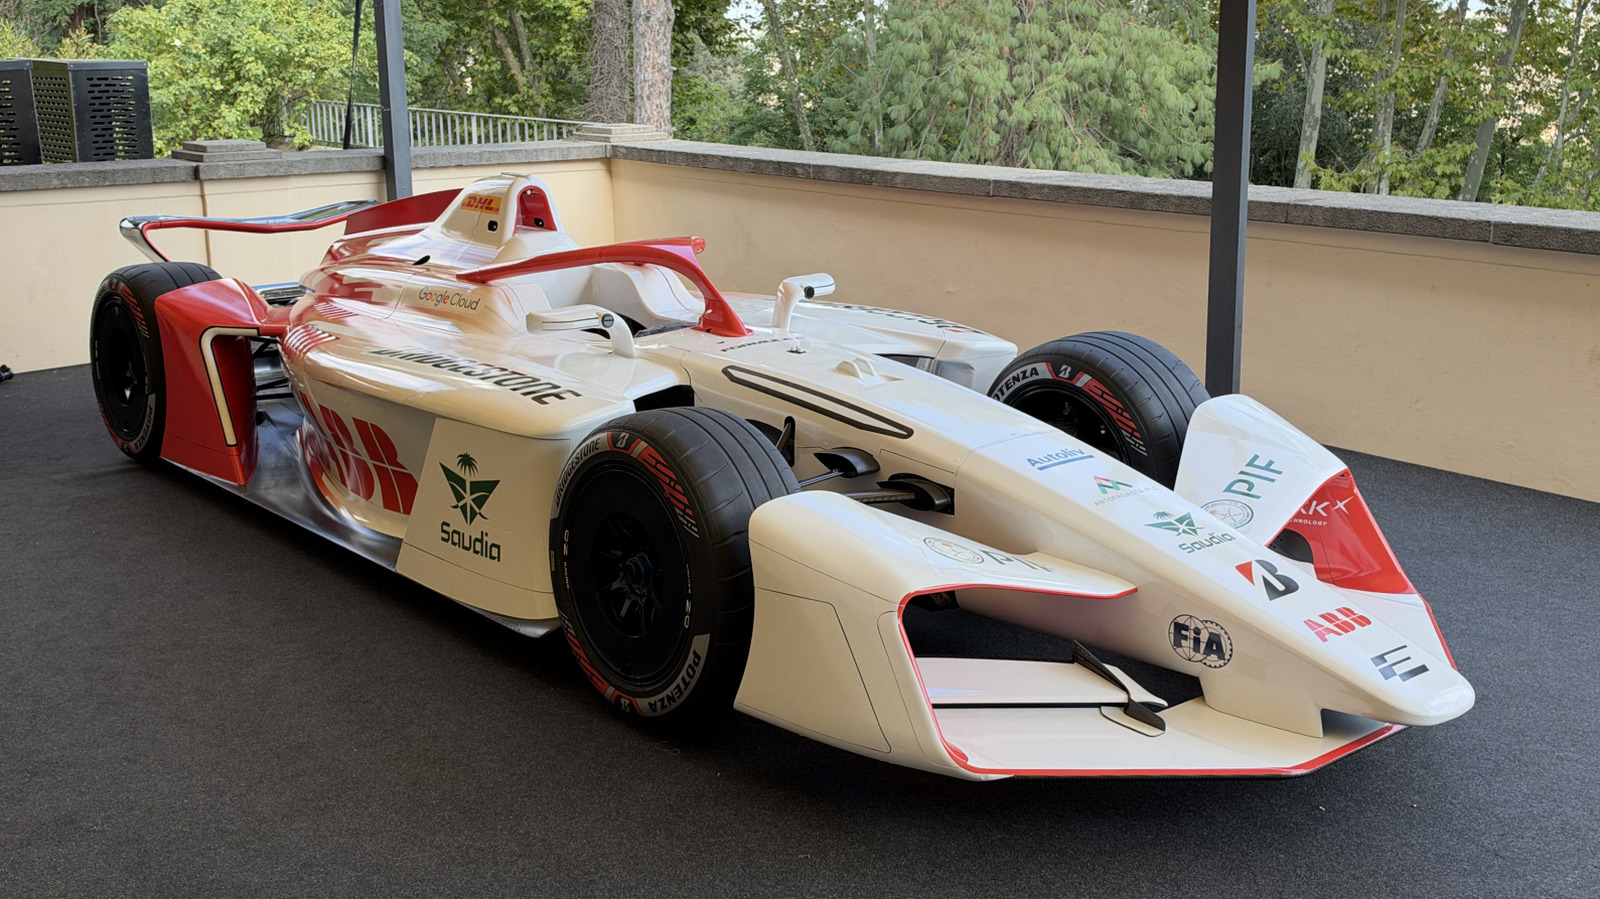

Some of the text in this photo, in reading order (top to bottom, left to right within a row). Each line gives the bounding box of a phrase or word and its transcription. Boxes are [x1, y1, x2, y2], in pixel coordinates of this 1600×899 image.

[466, 195, 495, 211] DHL
[418, 286, 481, 310] Google Cloud
[1026, 447, 1086, 468] Autoliv
[1222, 454, 1284, 500] PIF
[440, 520, 502, 562] Saudia
[1178, 531, 1237, 554] Saudia
[1303, 606, 1372, 643] ABB
[648, 649, 701, 714] POTENZA
